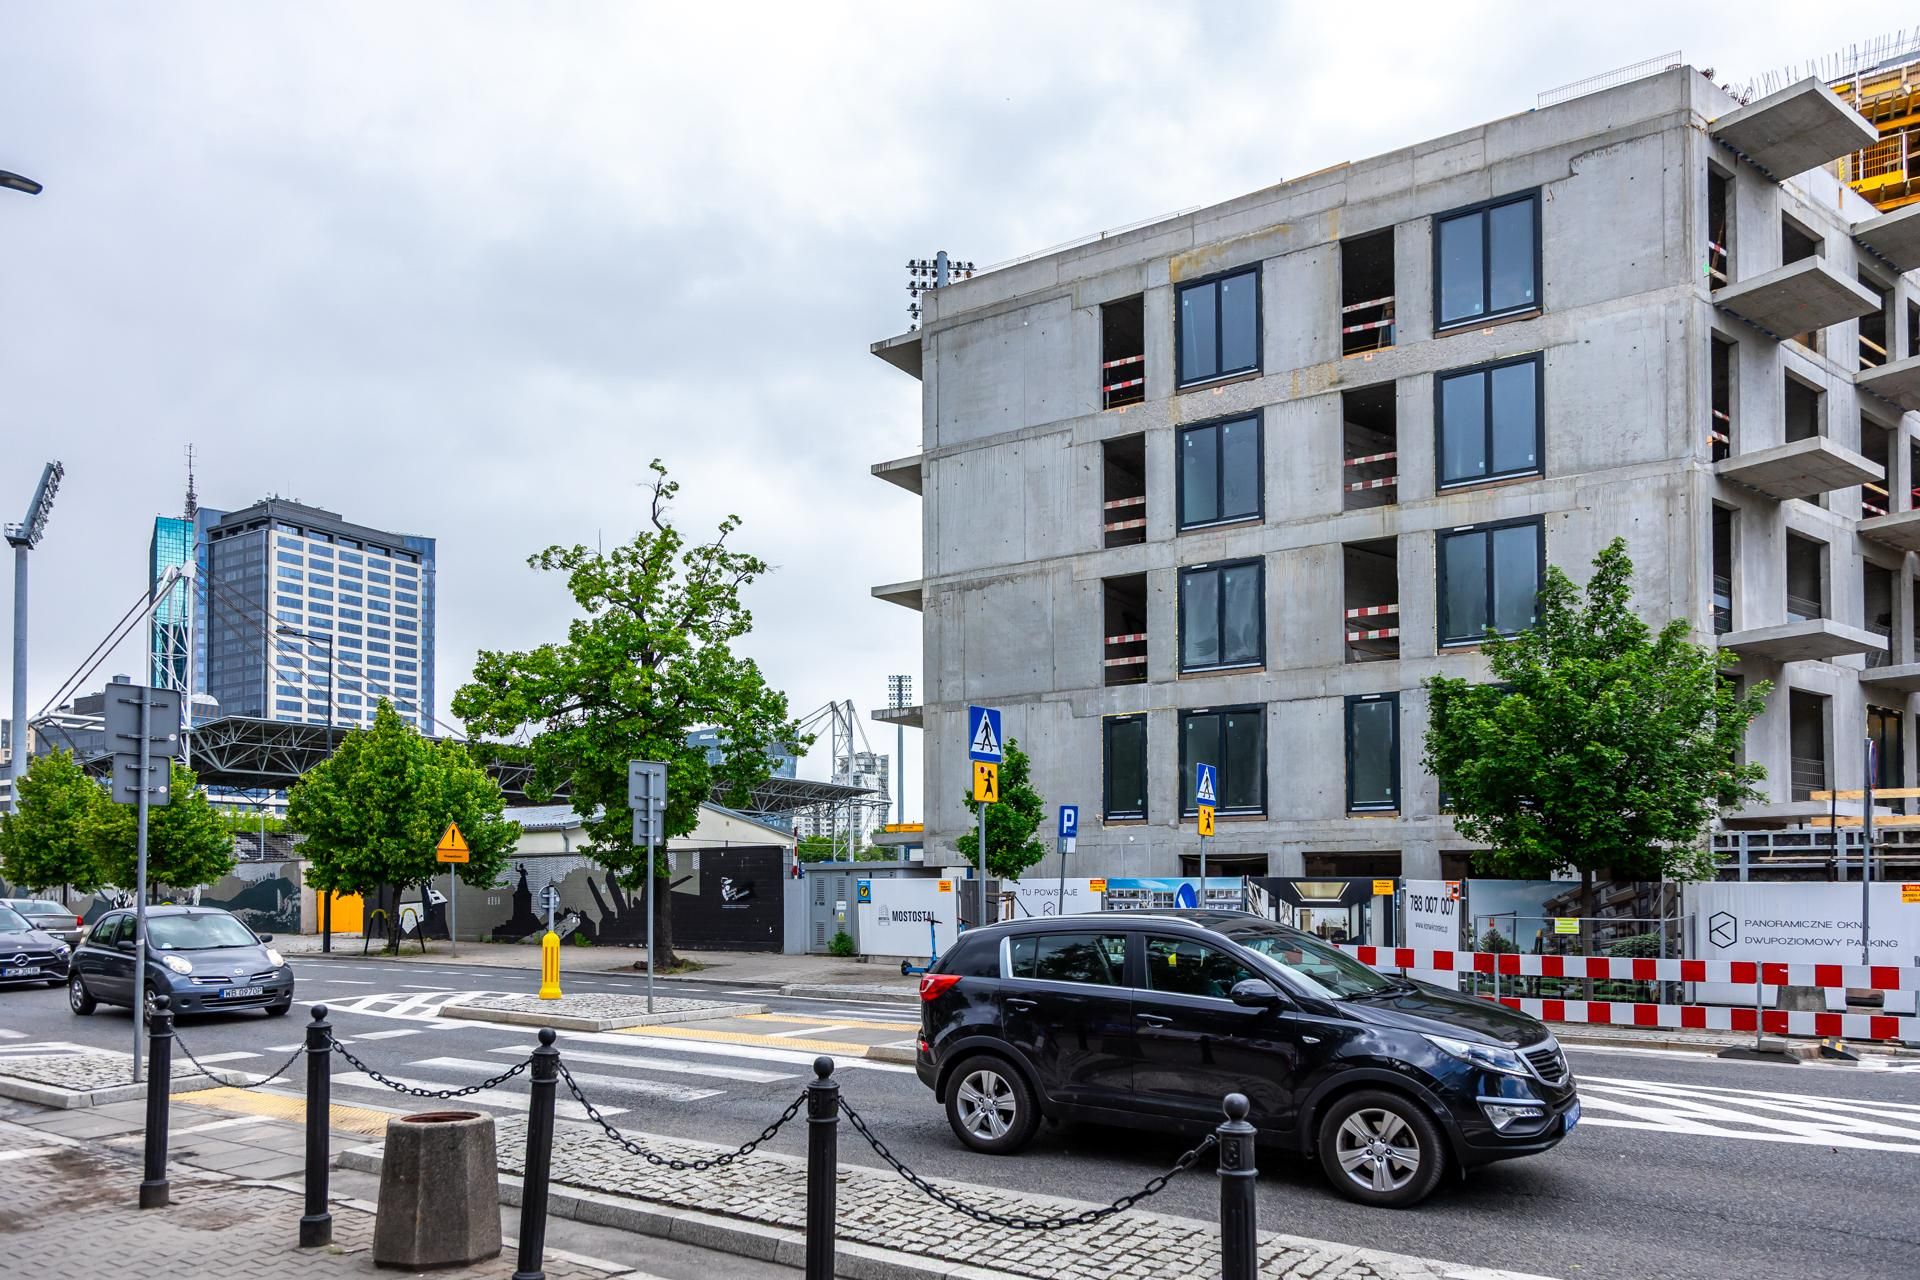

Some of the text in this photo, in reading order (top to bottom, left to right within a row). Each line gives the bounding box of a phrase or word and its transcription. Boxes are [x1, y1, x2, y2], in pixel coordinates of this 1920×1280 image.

[1064, 809, 1075, 834] P
[1410, 895, 1455, 916] 783 007 007
[1745, 920, 1870, 929] PANORAMICZNE OKN
[1745, 937, 1842, 946] DWUPOZIOMOWY
